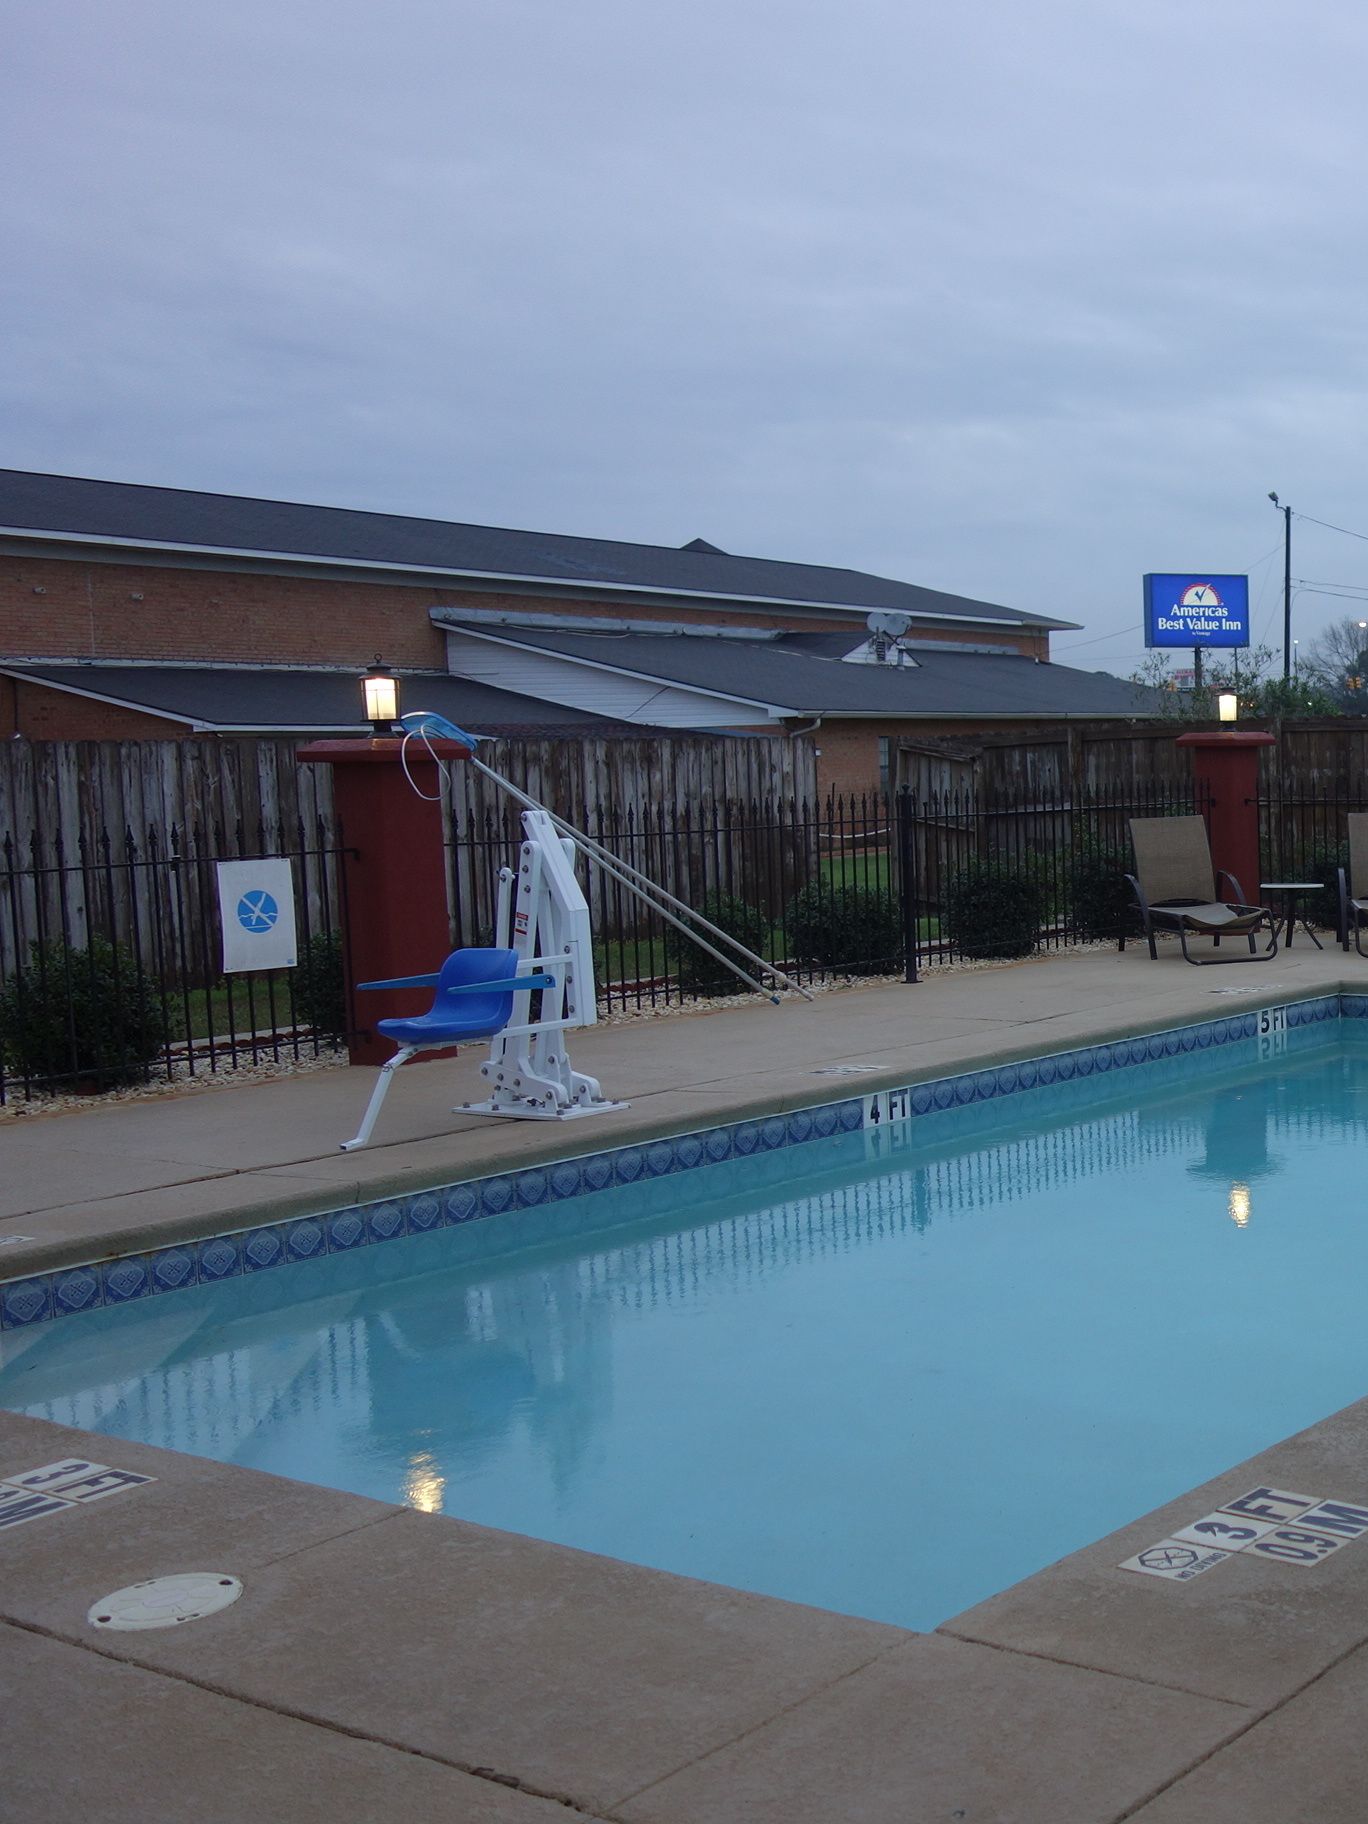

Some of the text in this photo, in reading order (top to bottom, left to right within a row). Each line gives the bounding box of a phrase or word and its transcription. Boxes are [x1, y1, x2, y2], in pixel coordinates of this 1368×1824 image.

[1158, 617, 1241, 630] Best Value Inn
[1170, 604, 1229, 616] Americas
[1261, 1006, 1285, 1033] 5 FT
[870, 1089, 909, 1124] 4 FT
[22, 1463, 151, 1499] 3 FT
[1194, 1487, 1311, 1541] 3 FT
